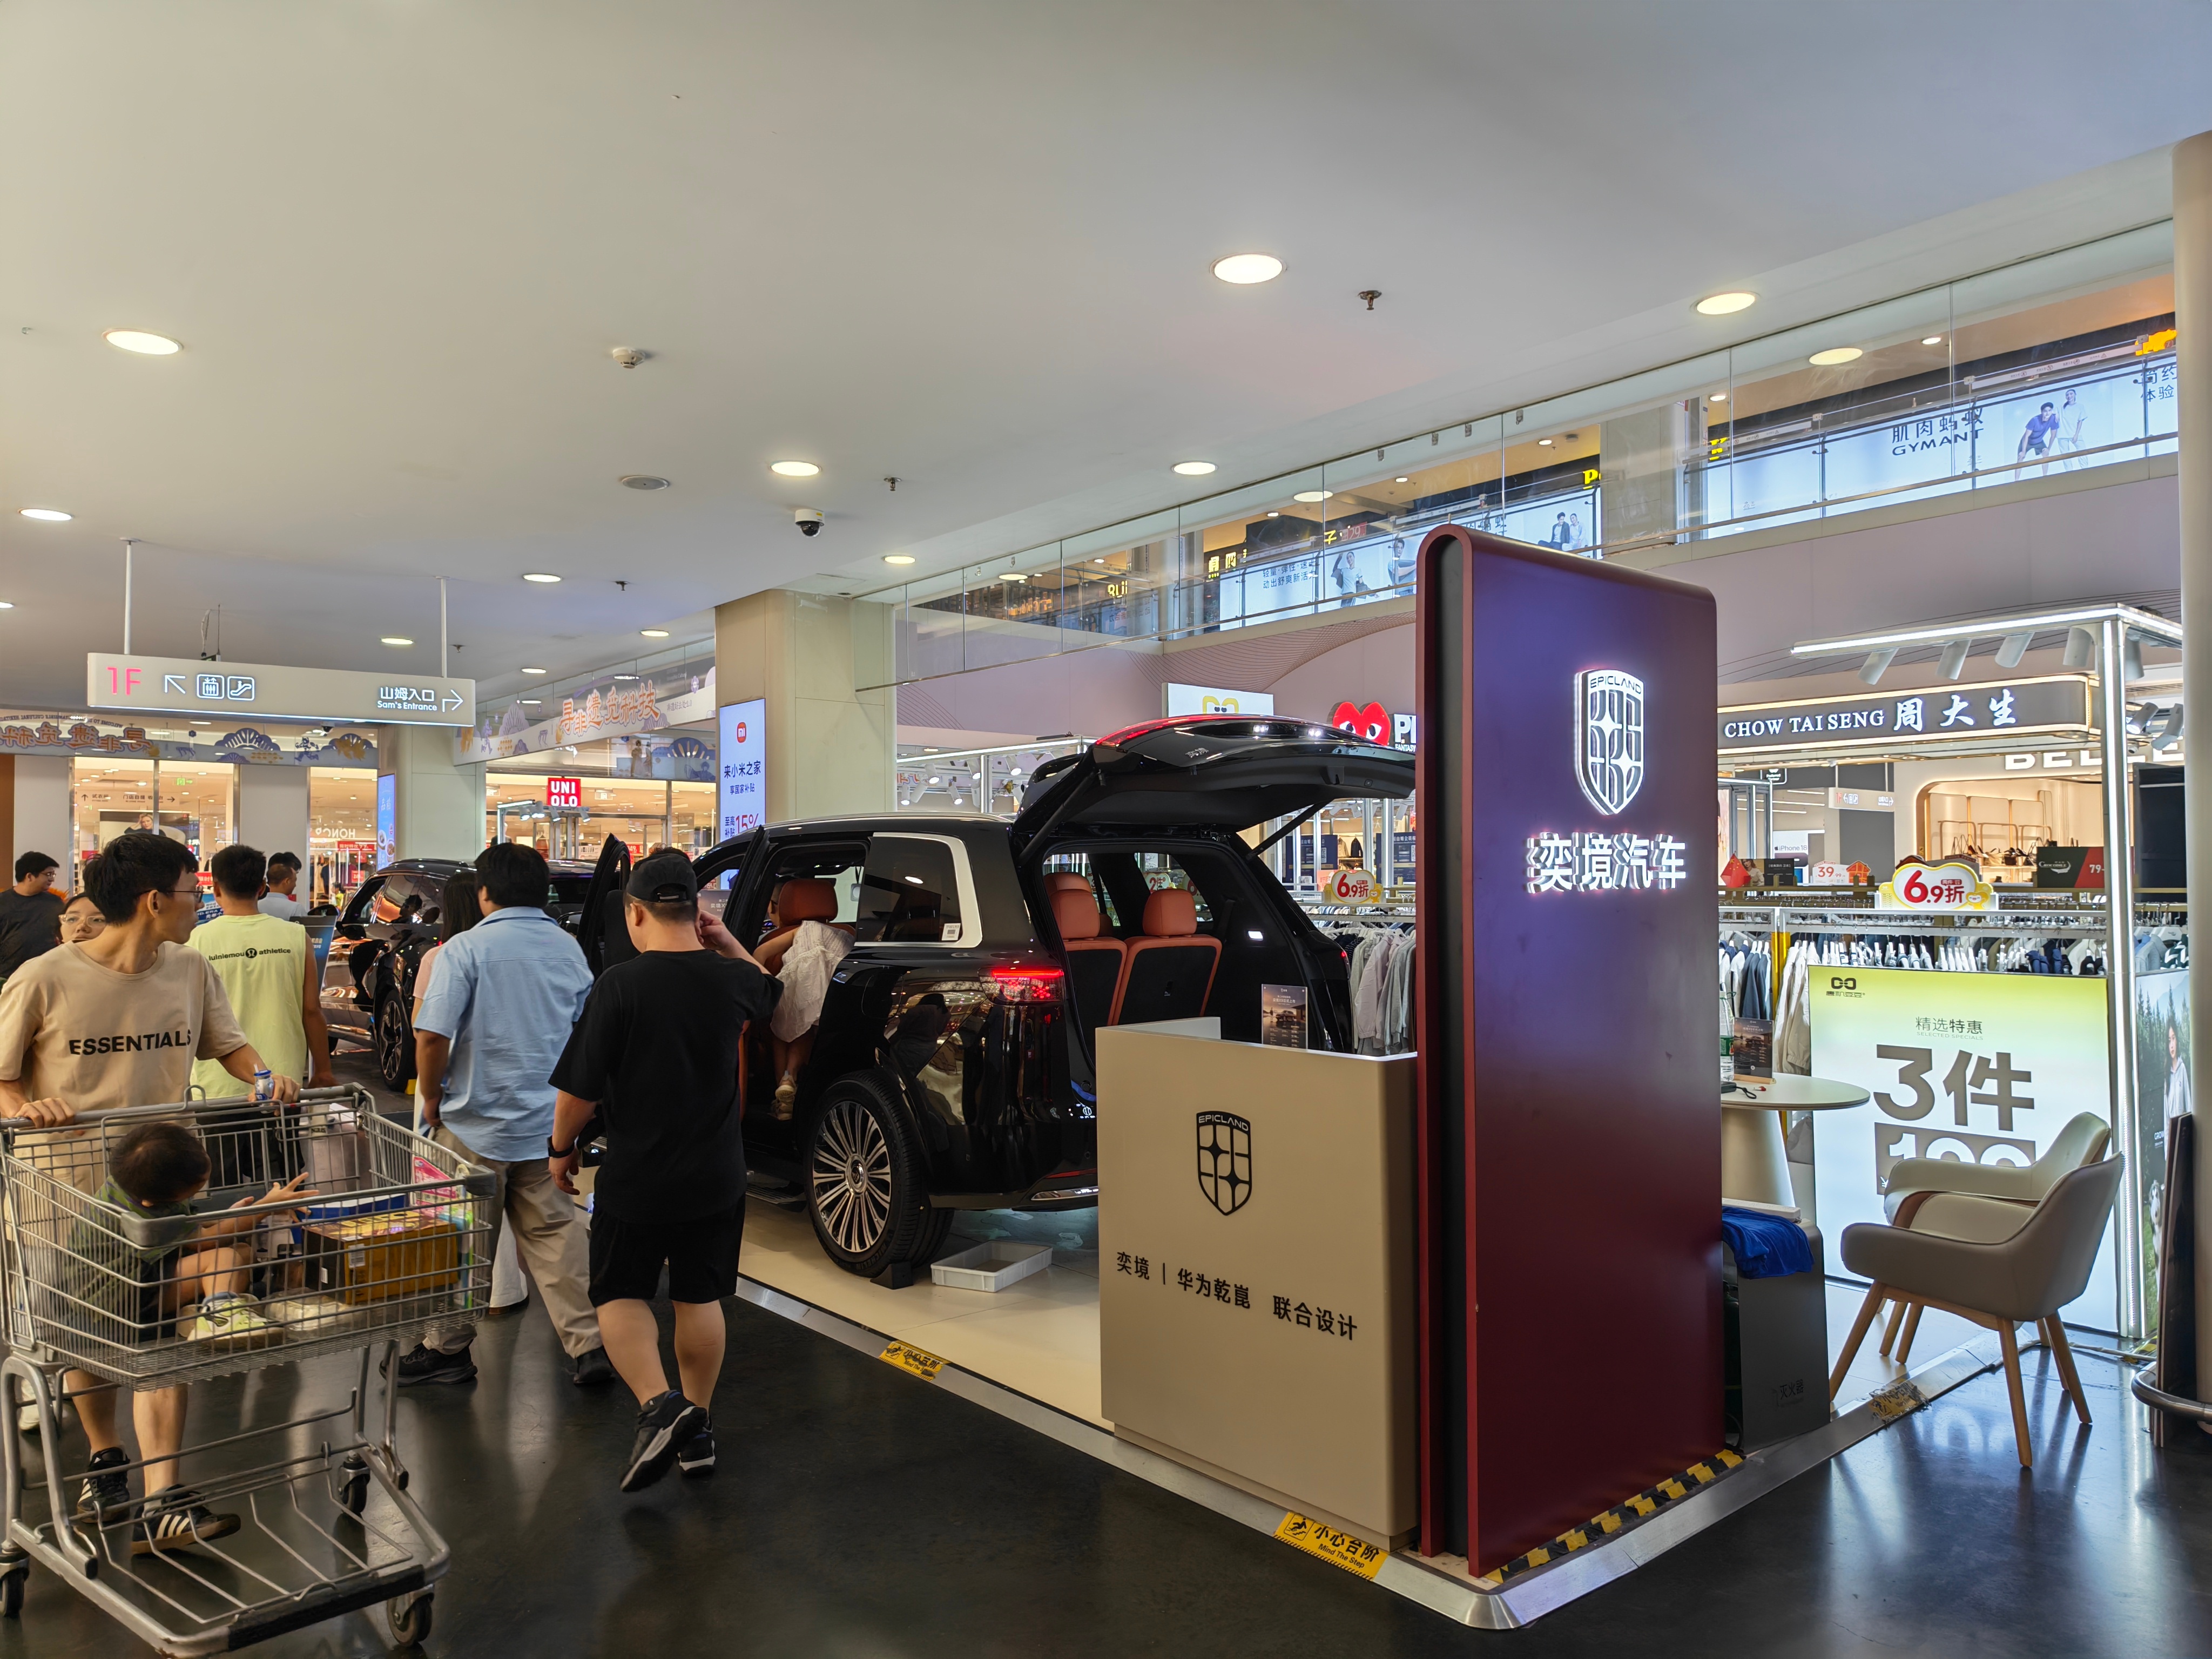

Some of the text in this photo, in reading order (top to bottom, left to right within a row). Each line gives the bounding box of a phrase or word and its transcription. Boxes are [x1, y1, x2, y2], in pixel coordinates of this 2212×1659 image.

[1892, 428, 1984, 456] GYMANT
[107, 667, 141, 695] 1F
[1590, 676, 1642, 696] EPICLAND
[377, 700, 437, 711] Sam's Entrance
[380, 686, 434, 702] 山姆入口
[1893, 689, 2016, 731] 周大生
[1724, 710, 1885, 738] CHOW TAI SENG
[724, 760, 761, 779] 来小米之家
[551, 780, 576, 794] UNI
[730, 783, 755, 795] 享国家补贴
[725, 816, 735, 826] 至高
[725, 828, 735, 838] 补贴
[1527, 832, 1686, 893] 奕境汽车
[1818, 866, 1835, 878] 39
[1337, 874, 1369, 898] 6.9折
[1904, 870, 1965, 903] 6.9折
[1916, 1016, 1982, 1035] 精选特惠
[69, 1029, 191, 1056] ESSENTIALS
[1873, 1044, 2035, 1132] 3件
[1198, 1114, 1249, 1132] EPICLAND
[1117, 1251, 1358, 1340] 奕境 华为乾崑 联合设计
[1314, 1526, 1380, 1562] 小心台阶
[1318, 1543, 1365, 1569] Mind The Step
